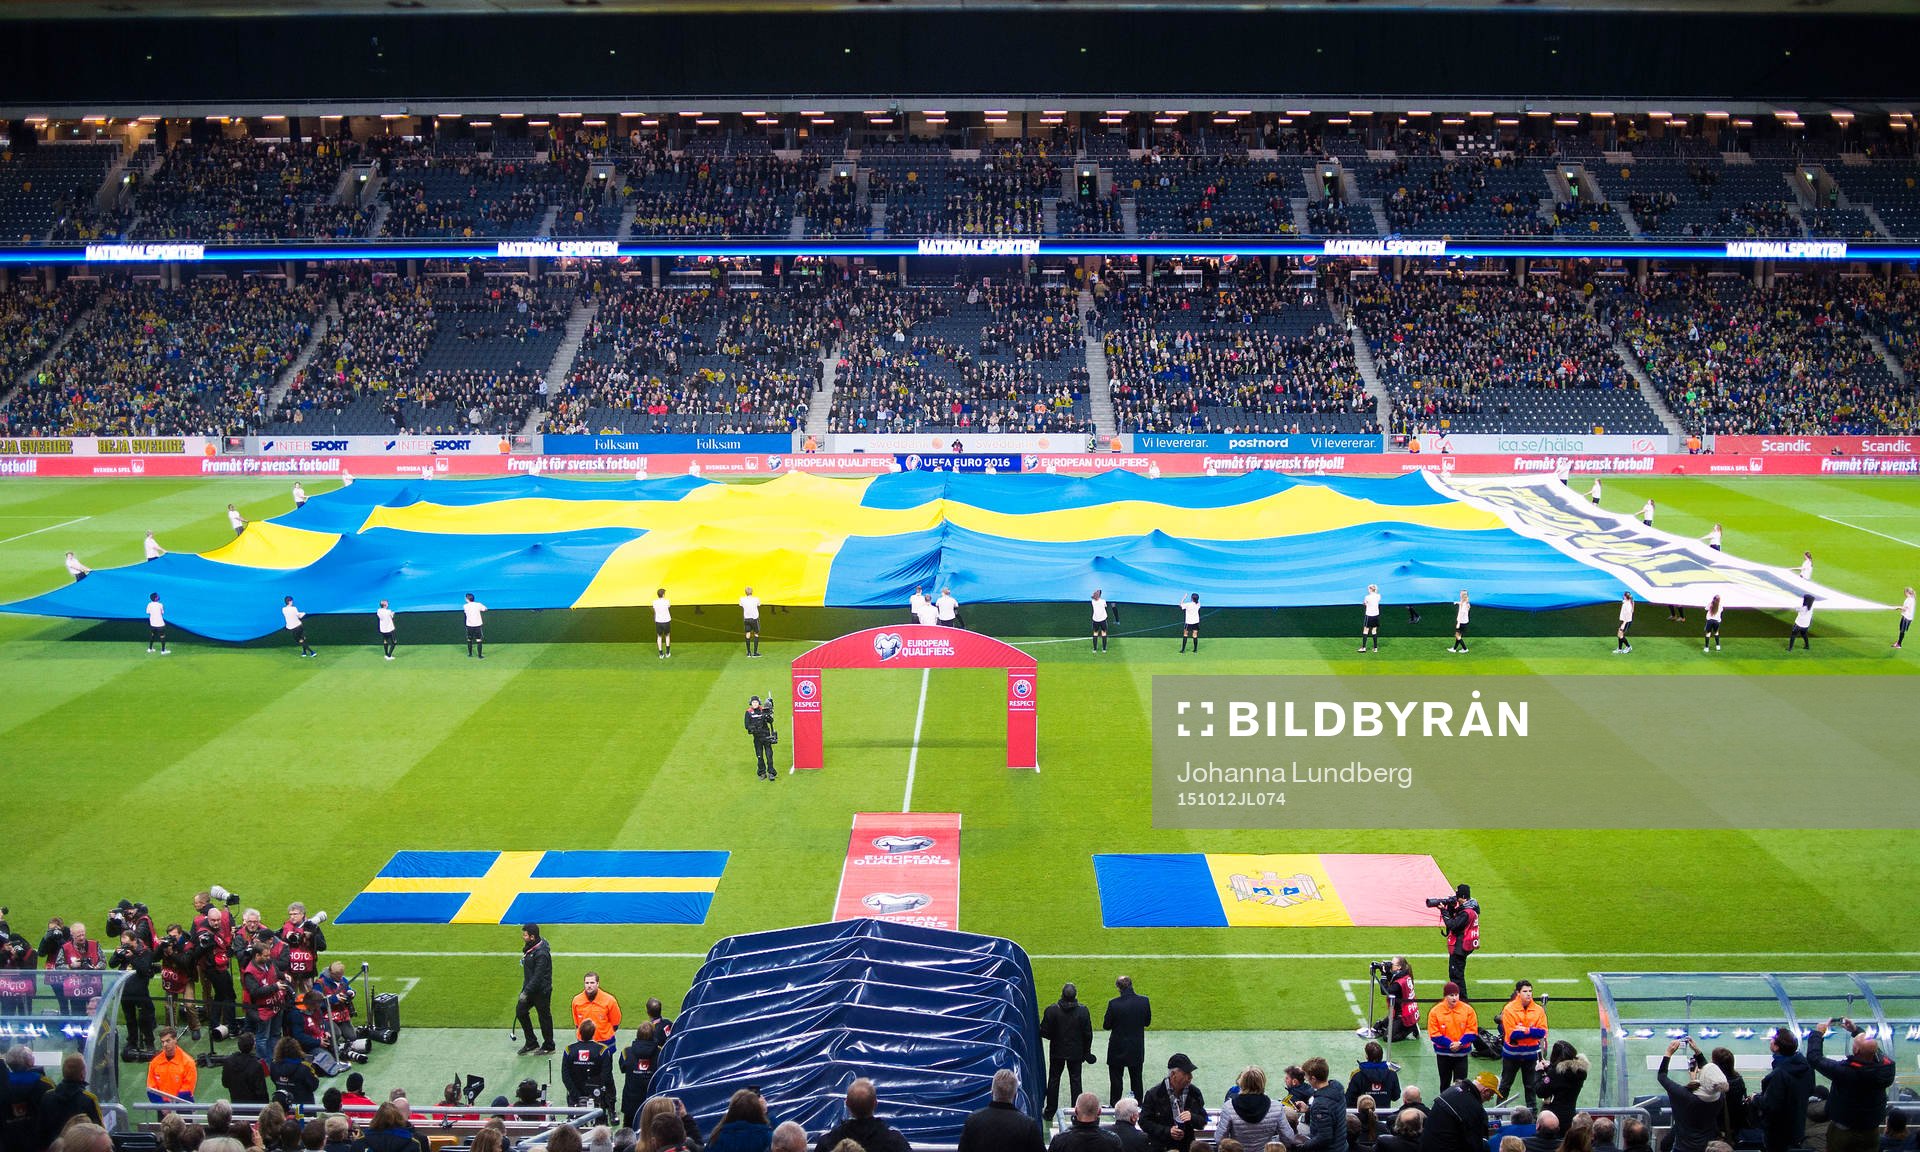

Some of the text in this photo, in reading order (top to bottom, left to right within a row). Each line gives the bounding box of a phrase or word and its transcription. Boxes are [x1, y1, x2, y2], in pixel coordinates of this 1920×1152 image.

[86, 245, 204, 260] NATIONALSPORTEN
[498, 241, 618, 257] NATIONALSPORTEN
[918, 239, 1040, 254] NATIONALSPORTEN
[1325, 240, 1446, 255] NATIONALSPORTEN
[1727, 242, 1847, 257] NATIONALSPORTEN
[20, 440, 73, 454] SVERIGE
[97, 440, 185, 454] HEJA SVERIGE
[276, 441, 349, 451] INTERSPORT
[397, 440, 471, 450] INTERSPORT
[595, 439, 639, 450] Folksam
[697, 438, 741, 449] Folksam
[1142, 437, 1209, 448] Vi levererar.
[1229, 438, 1289, 449] postnord
[1311, 437, 1377, 448] Vi levererar.
[1499, 437, 1583, 451] ica.se/hälsa
[1761, 440, 1811, 452] Scandic
[1862, 440, 1911, 452] Scandic
[202, 458, 340, 472] Framåt för svensk fotboll!
[549, 457, 567, 470] för
[567, 457, 604, 470] svensk
[605, 457, 648, 470] fotboll!
[785, 458, 891, 468] EUROPEAN QUALIFIERS
[924, 458, 1011, 467] UEFA EURO 2016
[1042, 458, 1149, 468] EUROPEAN QUALIFIERS
[1203, 456, 1244, 469] Framåt
[1245, 457, 1261, 469] för
[1264, 457, 1301, 469] svensk
[1514, 457, 1555, 470] Framåt
[1575, 457, 1611, 470] svensk
[1612, 457, 1654, 470] fotboll!
[1821, 458, 1917, 471] Framåt för svensk
[907, 639, 950, 648] EUROPEAN
[902, 647, 955, 657] QUALIFIERS
[290, 952, 312, 960] HOTO
